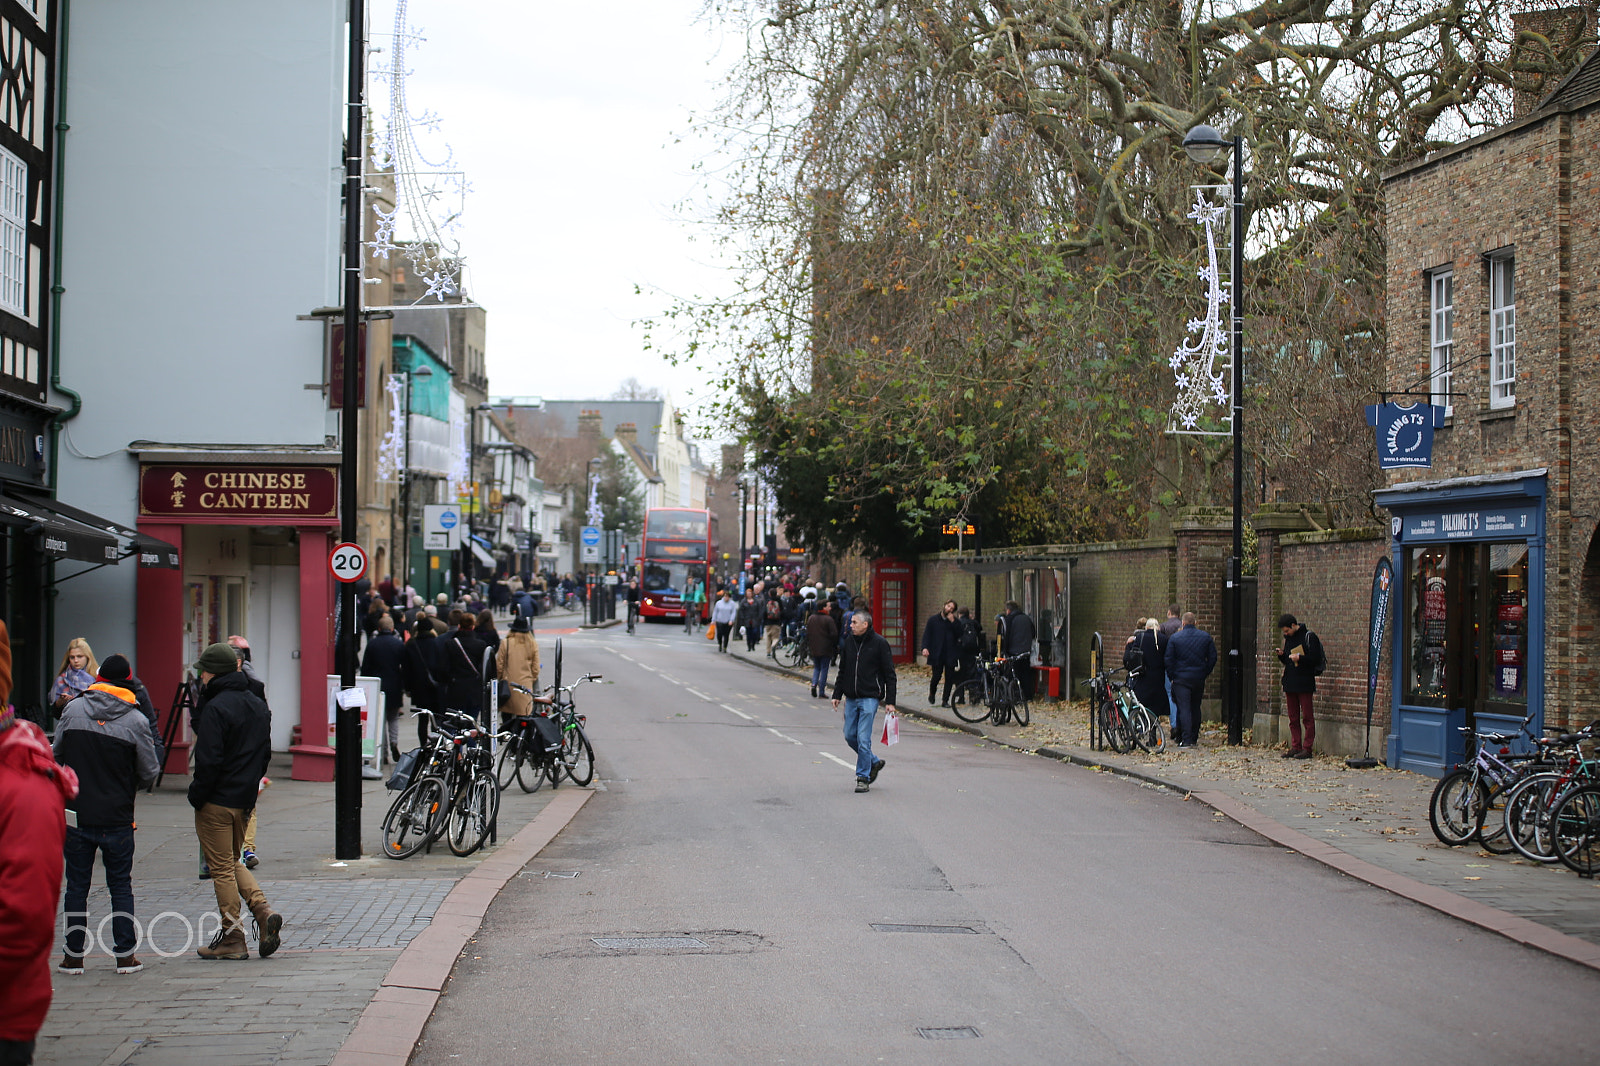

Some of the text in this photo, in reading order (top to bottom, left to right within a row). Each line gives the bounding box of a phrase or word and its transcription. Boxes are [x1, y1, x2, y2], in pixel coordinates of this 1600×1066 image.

[1387, 413, 1425, 454] TALKING T'S
[204, 472, 306, 489] CHINESE
[170, 471, 188, 508] 食堂
[199, 492, 311, 509] CANTEEN
[1441, 512, 1479, 532] TALKING T'S
[1520, 514, 1527, 528] 37
[334, 553, 362, 570] 20
